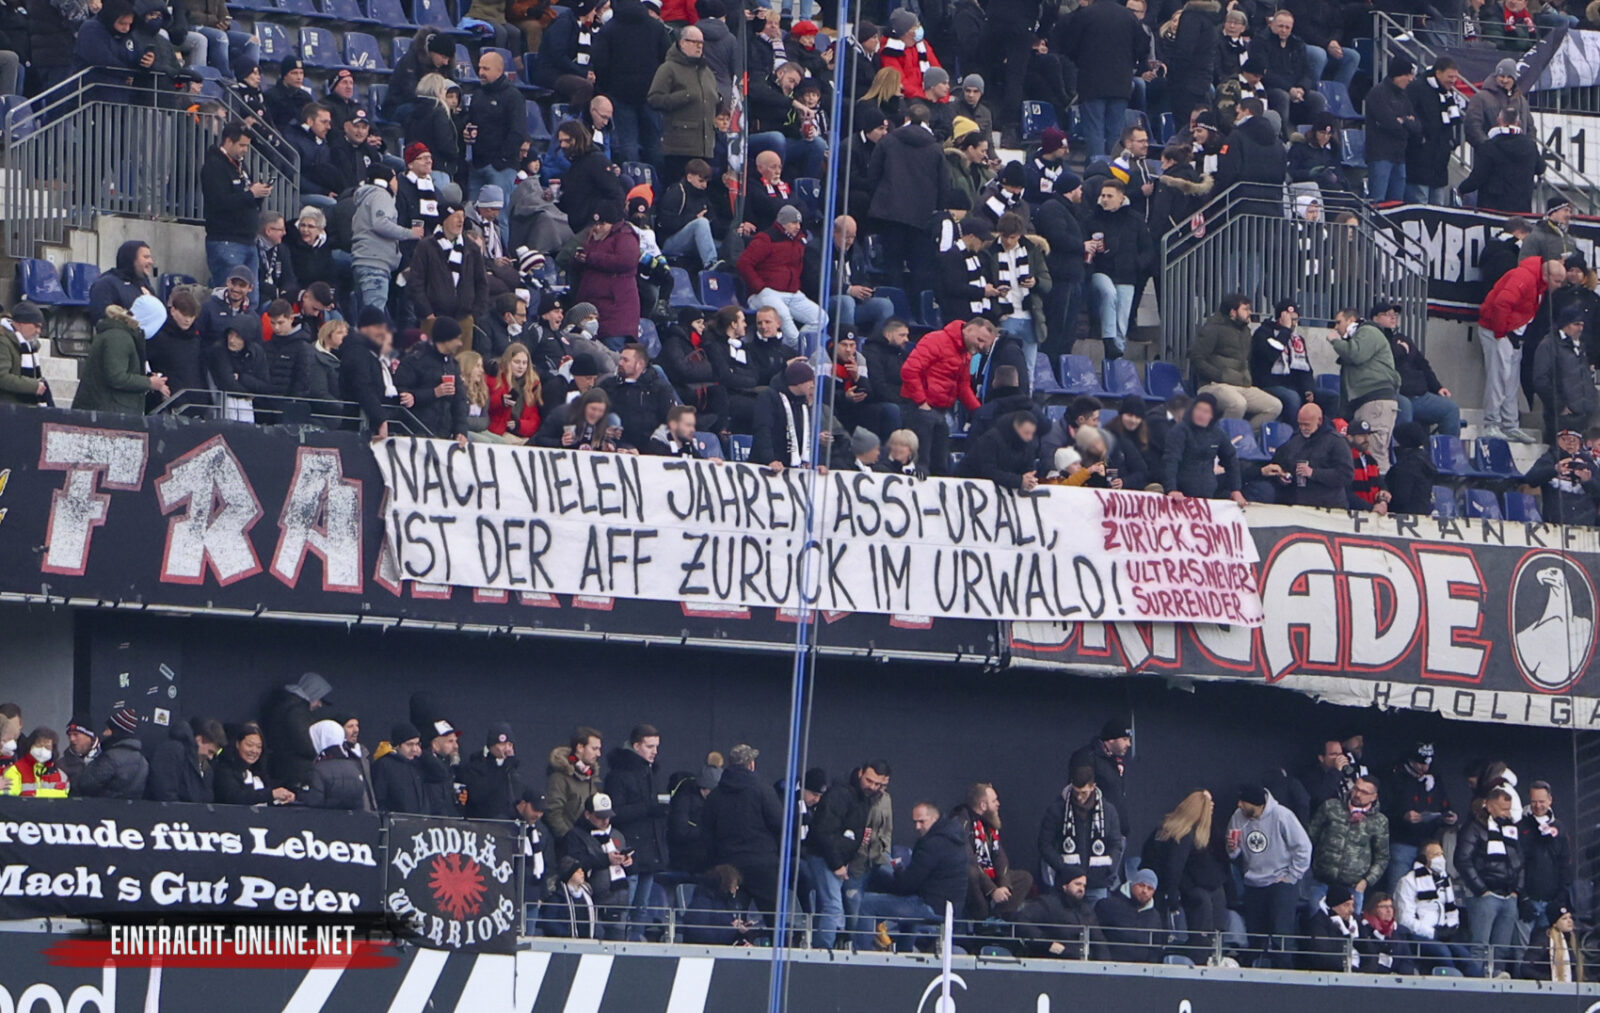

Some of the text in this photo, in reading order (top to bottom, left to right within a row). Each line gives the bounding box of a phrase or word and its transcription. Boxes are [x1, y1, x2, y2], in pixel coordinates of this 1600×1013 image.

[385, 437, 500, 510] NACH
[511, 449, 644, 523] VIELEN
[662, 460, 814, 534] JAHREN
[1094, 490, 1212, 523] WILLKOMMEN
[1349, 510, 1600, 549] FRANKF
[392, 509, 457, 582] IST
[476, 515, 554, 590] DER
[579, 524, 659, 595] AFF
[678, 531, 857, 610] ZURÜCK
[868, 543, 912, 611] IM
[933, 549, 1126, 619] URWALD!
[150, 822, 243, 854] fürs
[248, 827, 377, 866] Leben
[150, 871, 229, 906] Gut
[233, 876, 361, 913] Peter
